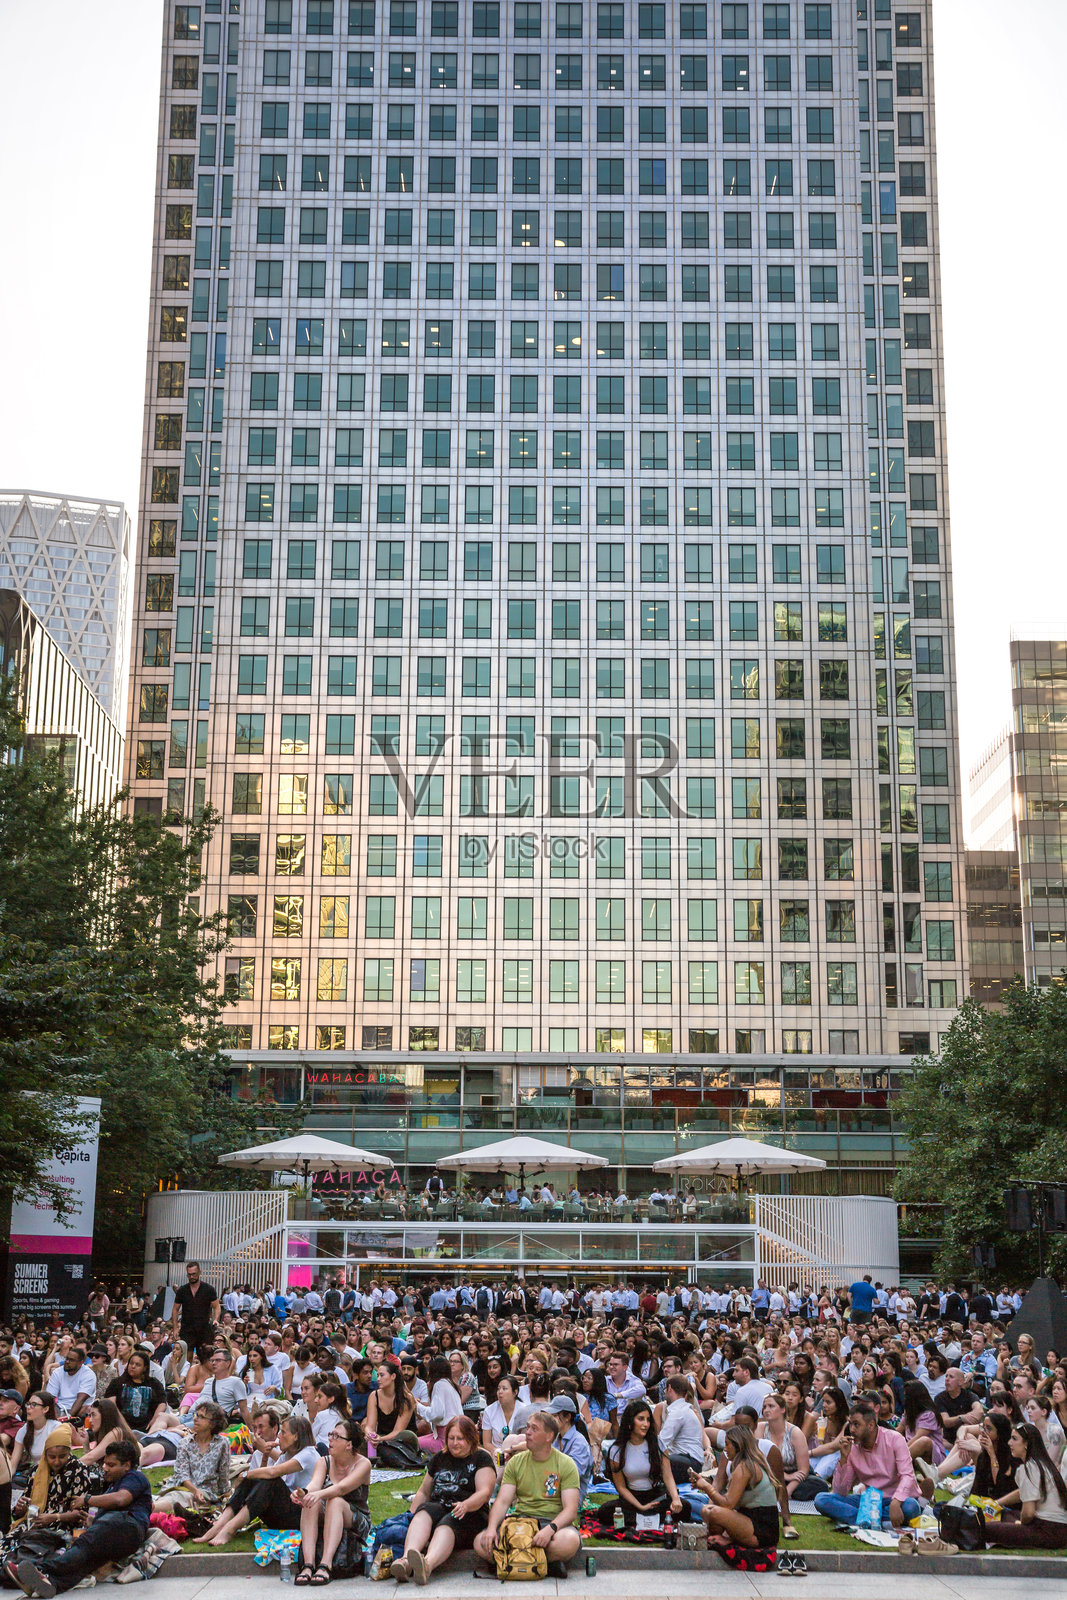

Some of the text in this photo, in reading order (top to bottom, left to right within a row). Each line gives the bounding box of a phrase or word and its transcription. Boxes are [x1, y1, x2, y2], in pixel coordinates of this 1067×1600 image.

[307, 1072, 376, 1083] WAHACA
[681, 1178, 728, 1191] ROKA
[14, 1264, 48, 1278] SUMMER
[13, 1278, 48, 1294] SCREENS
